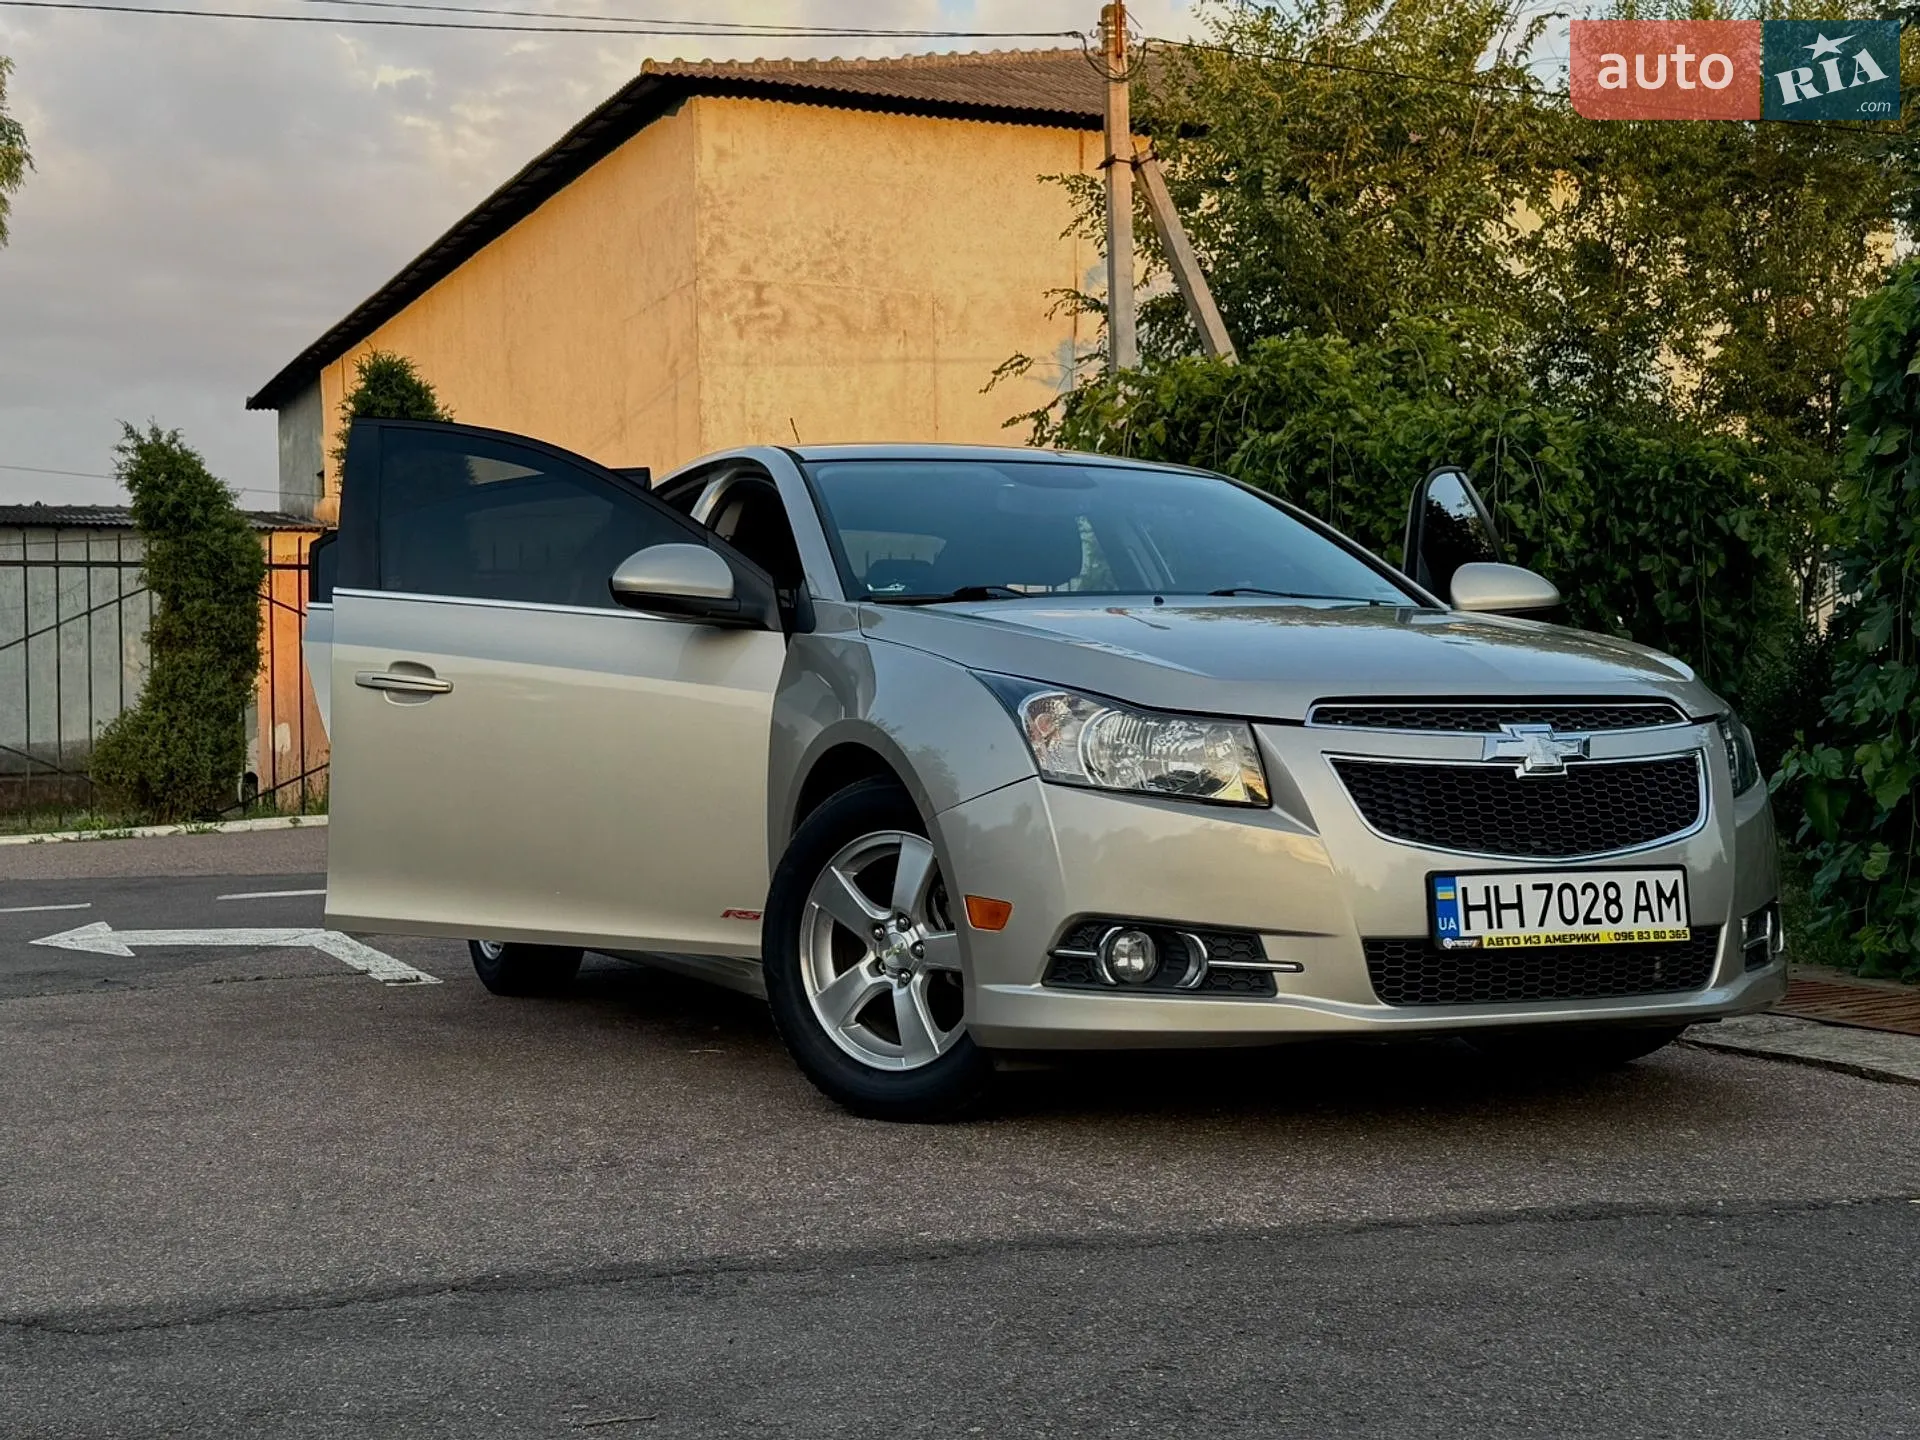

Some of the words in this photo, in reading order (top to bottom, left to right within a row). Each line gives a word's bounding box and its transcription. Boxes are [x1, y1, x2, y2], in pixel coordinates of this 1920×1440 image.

[1461, 884, 1526, 931] HH
[1532, 881, 1624, 928] 7028
[1633, 879, 1682, 923] AM
[1438, 916, 1457, 931] UA
[1486, 936, 1521, 947] АВТО
[1523, 935, 1541, 945] ИЗ
[1543, 932, 1600, 944] АМЕРИКИ
[1613, 932, 1635, 942] 096
